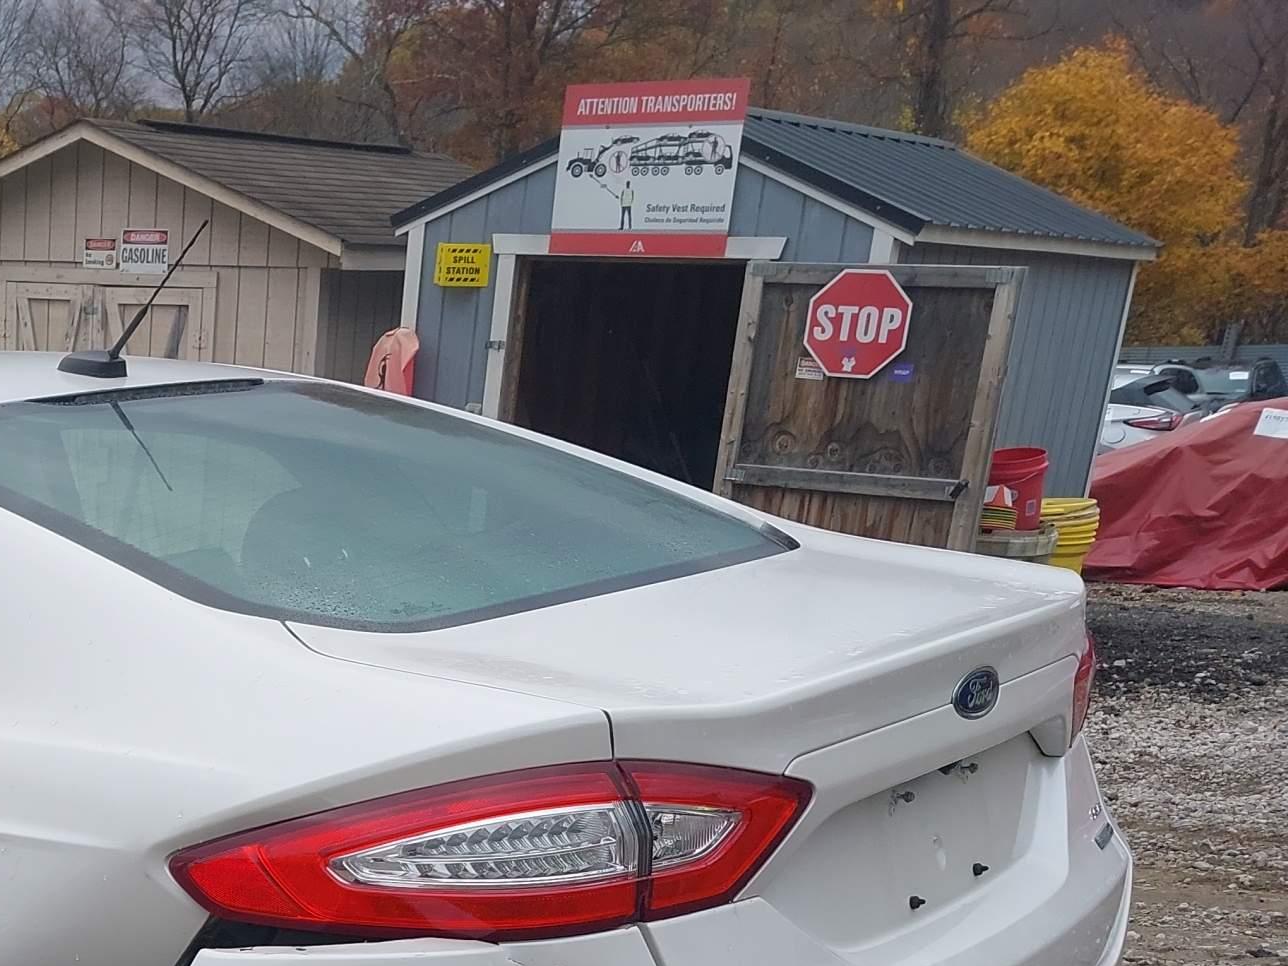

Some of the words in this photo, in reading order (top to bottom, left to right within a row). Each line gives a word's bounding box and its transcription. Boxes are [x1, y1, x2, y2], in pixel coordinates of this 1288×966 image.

[577, 96, 639, 116] ATTENTION
[641, 92, 737, 113] TRANSPORTERS!
[645, 203, 670, 214] Safety
[672, 203, 688, 213] Vest
[690, 203, 725, 214] Required
[122, 247, 167, 264] GASOLINE
[453, 255, 475, 264] SPILL
[446, 266, 481, 275] STATION
[813, 304, 902, 343] STOP
